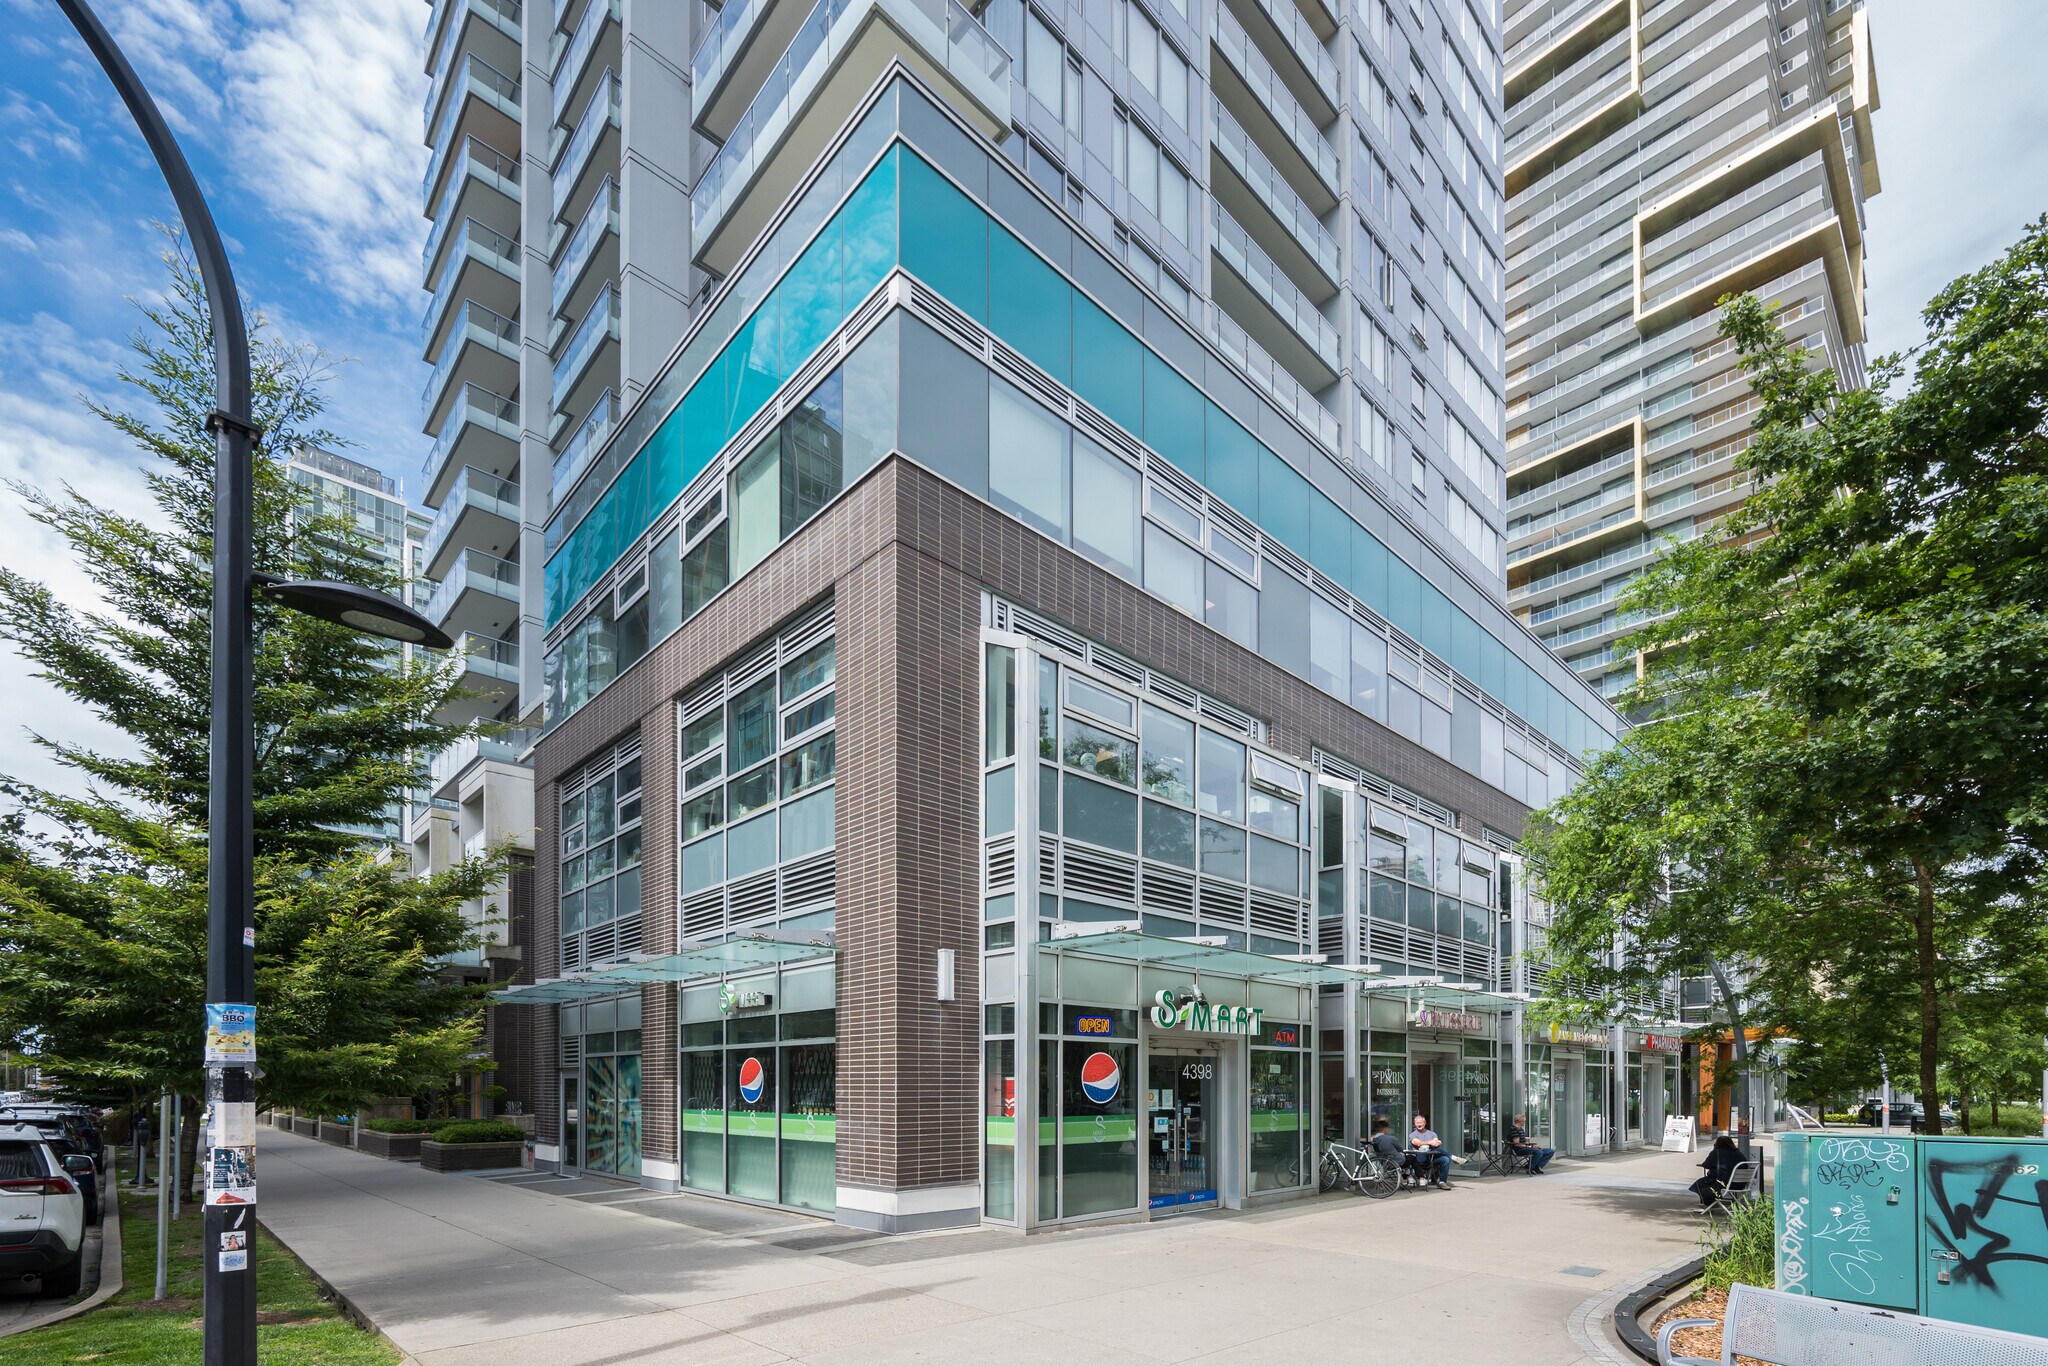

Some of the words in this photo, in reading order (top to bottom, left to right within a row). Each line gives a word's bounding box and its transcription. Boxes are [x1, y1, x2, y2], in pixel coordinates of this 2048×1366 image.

[222, 1014, 245, 1022] BBQ
[1078, 1018, 1109, 1033] OPEN
[1275, 1031, 1296, 1043] ATM
[1182, 1064, 1213, 1080] 4398
